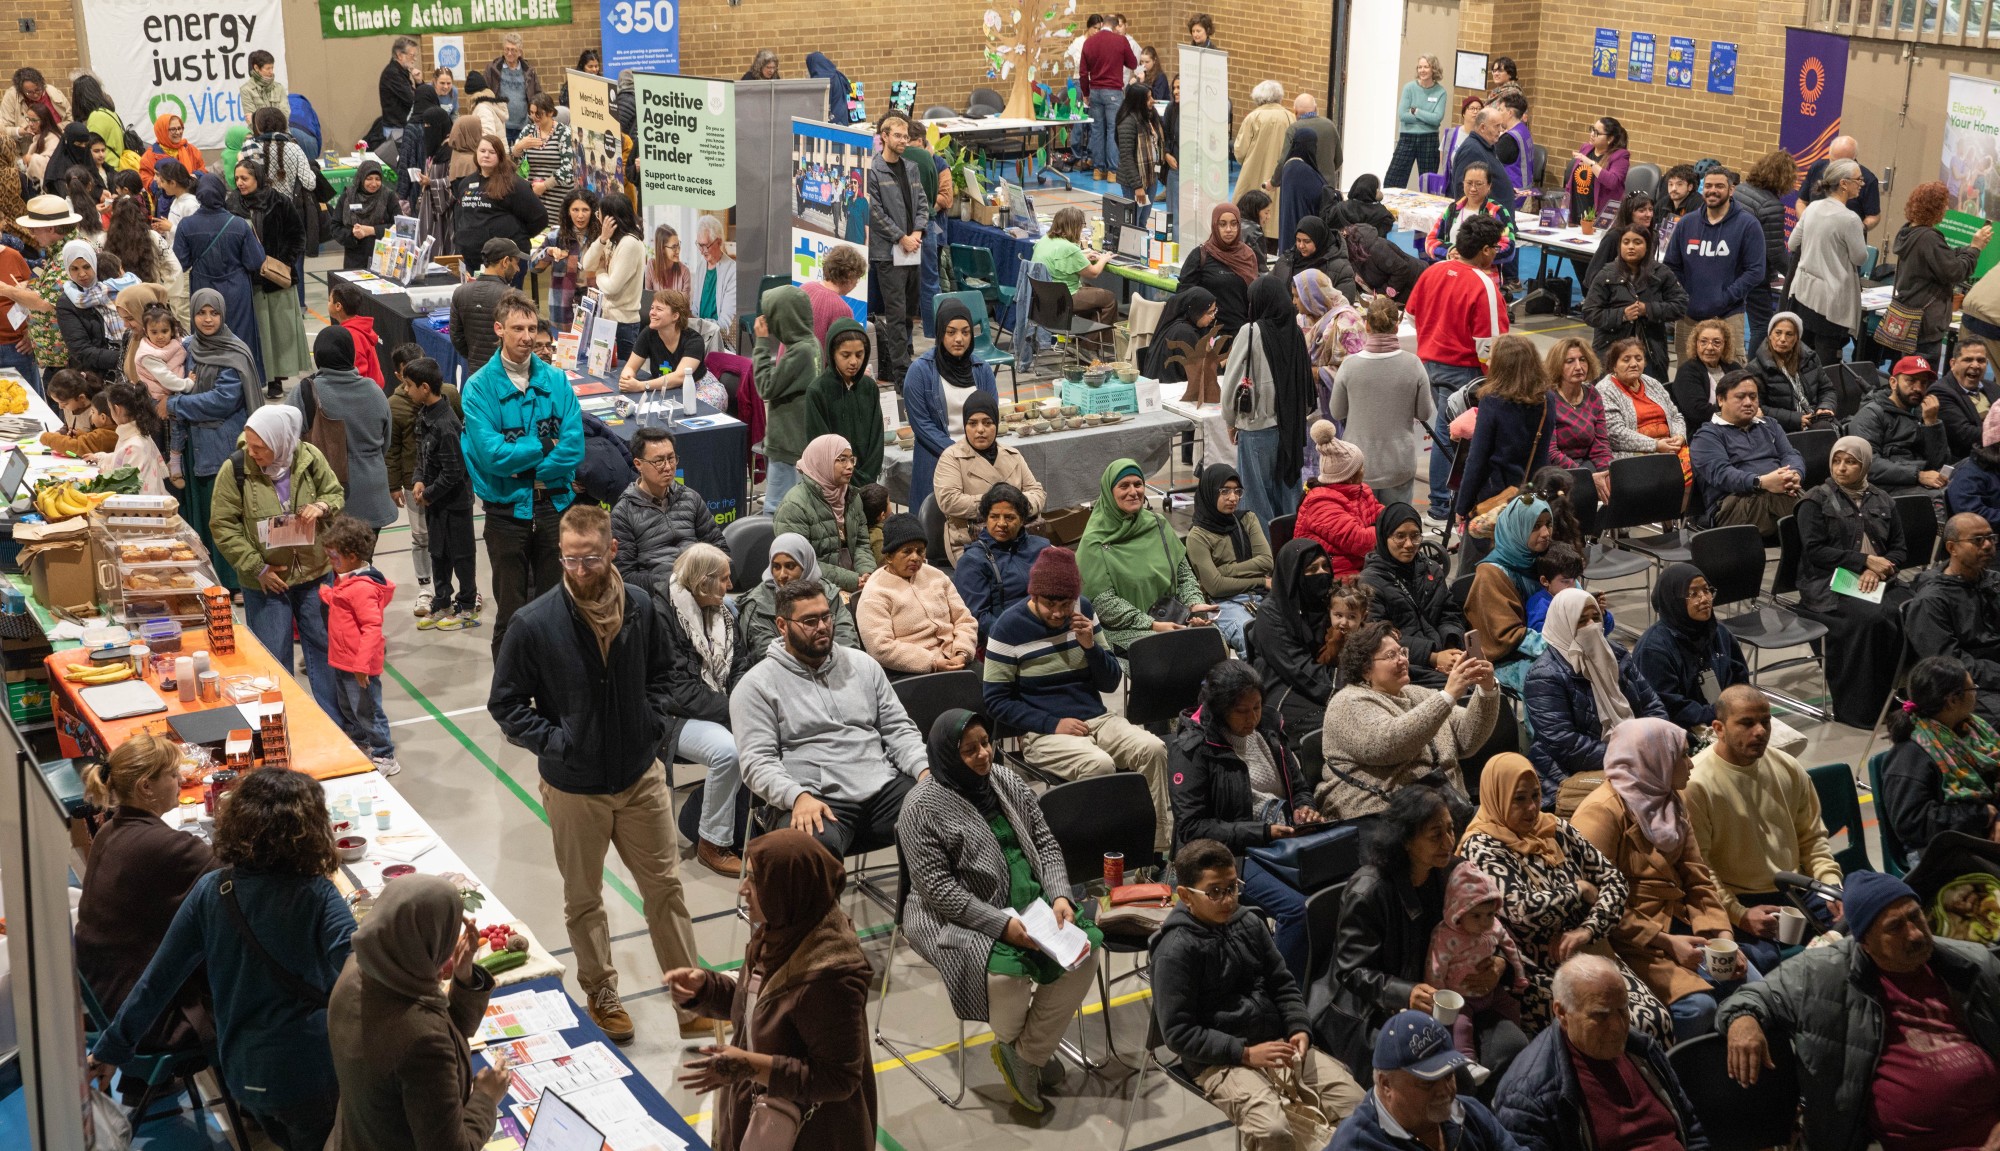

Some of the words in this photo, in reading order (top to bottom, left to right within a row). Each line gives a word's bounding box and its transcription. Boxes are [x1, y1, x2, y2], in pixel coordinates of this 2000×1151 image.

[333, 4, 401, 31] Climate
[411, 0, 463, 28] Action
[615, 1, 674, 34] 350
[143, 13, 256, 54] energy
[579, 92, 605, 106] Merri-bek
[642, 88, 703, 110] Positive
[581, 106, 604, 121] Libraries
[1800, 101, 1817, 117] SEC
[1951, 101, 1988, 121] Electrify
[642, 107, 698, 133] Ageing
[1950, 114, 1972, 129] Your
[1973, 119, 2000, 136] Home
[643, 126, 680, 145] Care
[644, 144, 693, 165] Finder
[644, 169, 677, 181] Support
[677, 173, 686, 182] to
[686, 175, 713, 186] access
[645, 181, 666, 190] aged
[666, 183, 684, 192] care
[684, 186, 716, 197] services
[477, 201, 492, 209] Lives
[1686, 239, 1730, 257] FILA
[706, 500, 720, 510] for
[722, 498, 736, 508] the
[1710, 954, 1734, 965] TOP
